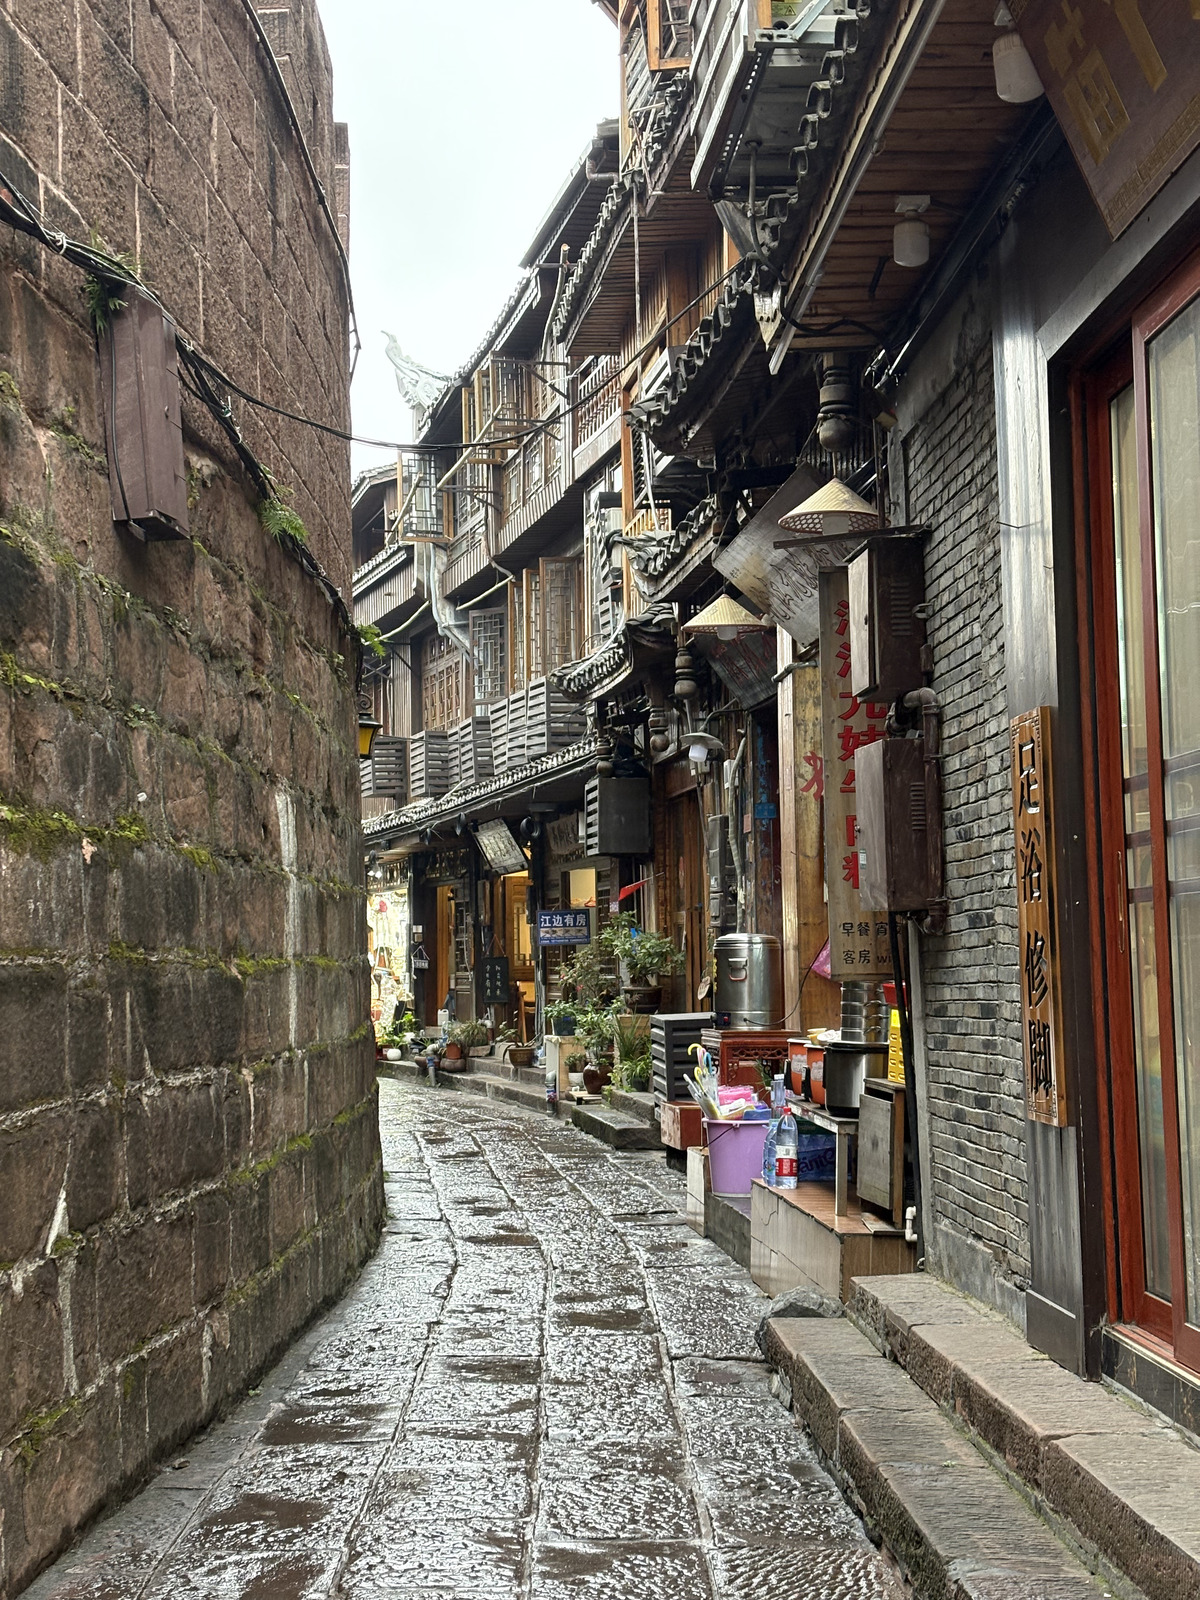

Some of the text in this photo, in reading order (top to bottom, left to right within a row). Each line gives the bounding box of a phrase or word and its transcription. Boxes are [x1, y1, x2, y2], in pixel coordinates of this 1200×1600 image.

[540, 914, 587, 928] 江边有房
[1018, 737, 1051, 1098] 足浴修脚
[842, 949, 871, 965] 客房
